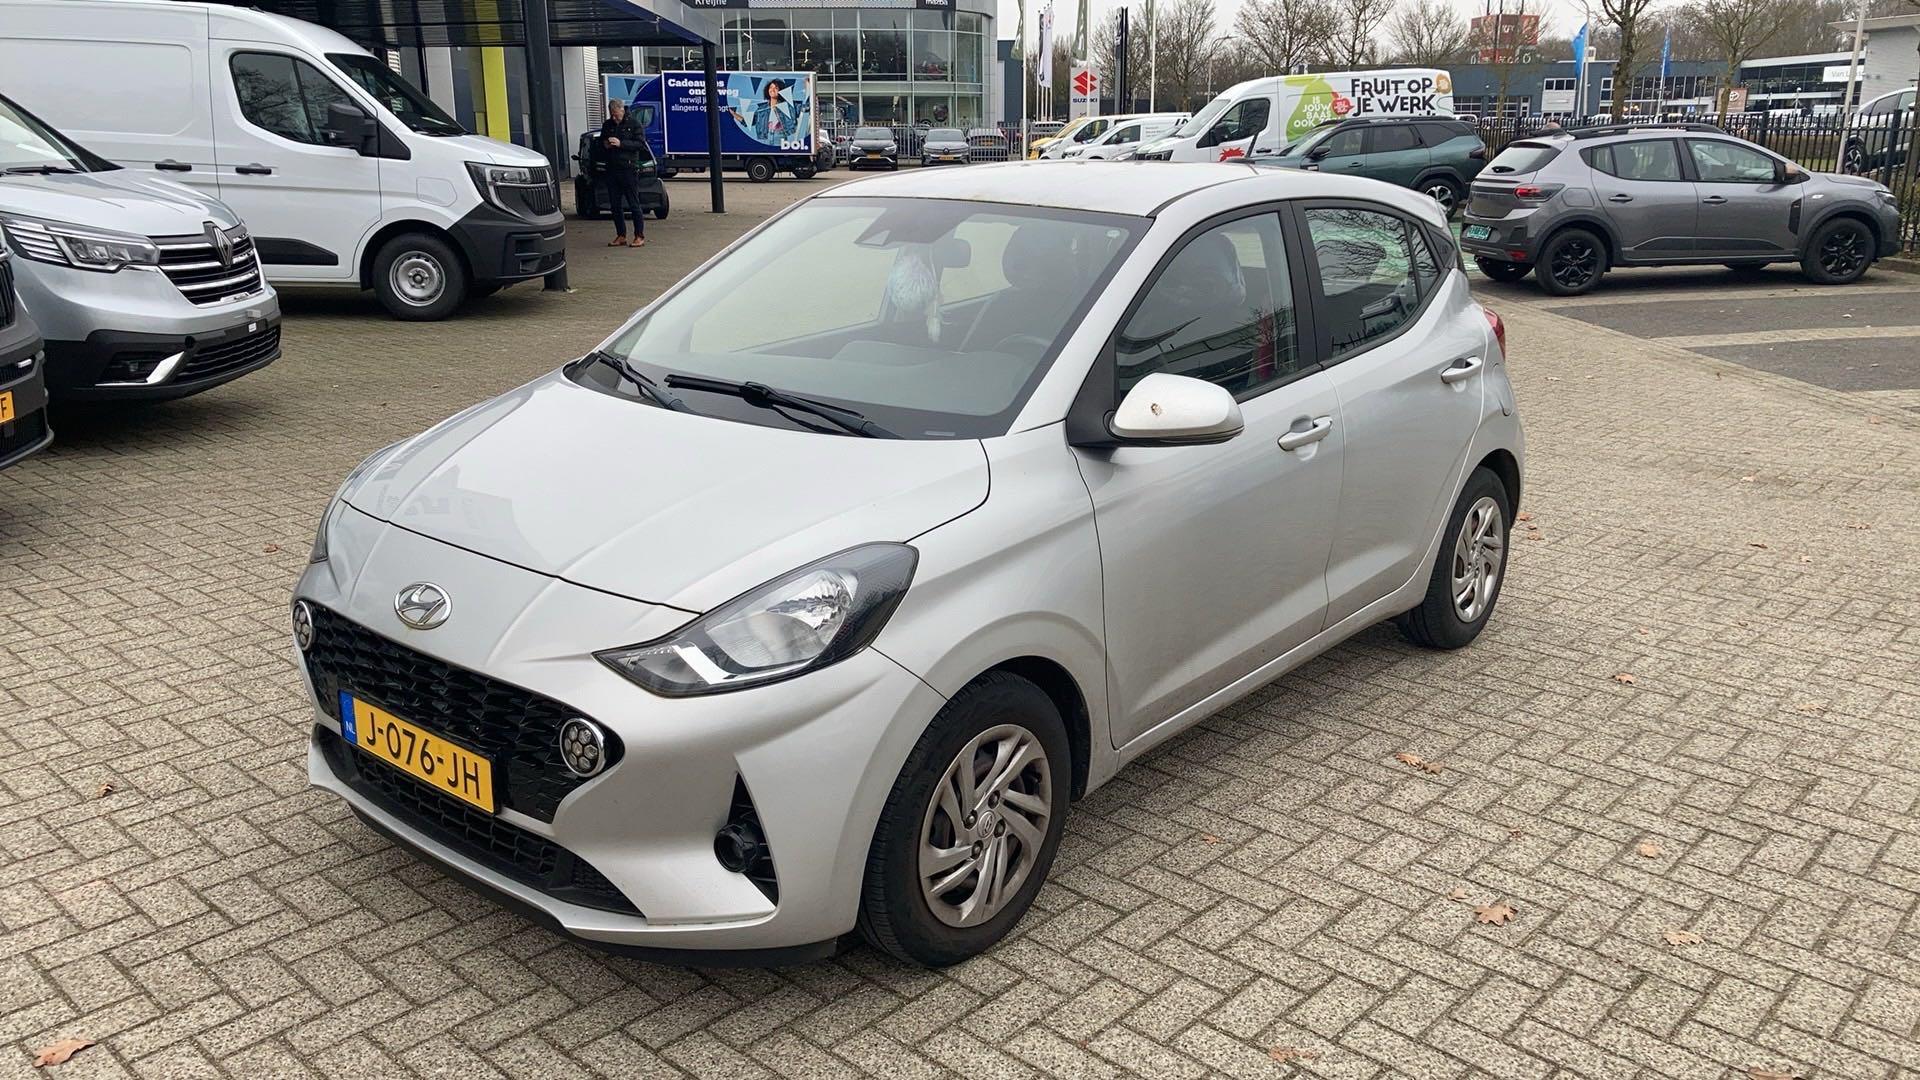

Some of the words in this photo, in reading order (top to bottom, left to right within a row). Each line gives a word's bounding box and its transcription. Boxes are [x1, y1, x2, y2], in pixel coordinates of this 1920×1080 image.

[668, 78, 725, 87] Cadeaus
[1351, 78, 1404, 98] FRUIT
[1407, 77, 1433, 93] OP
[688, 86, 739, 96] ondweg
[1312, 96, 1321, 104] IS
[671, 105, 700, 113] slingers
[1302, 104, 1331, 112] JOUW
[1352, 97, 1374, 117] JE
[1378, 94, 1436, 114] WERK
[1293, 119, 1316, 128] OOK
[780, 139, 809, 150] bol.
[345, 721, 356, 735] NL
[366, 712, 481, 800] J-076-JH
